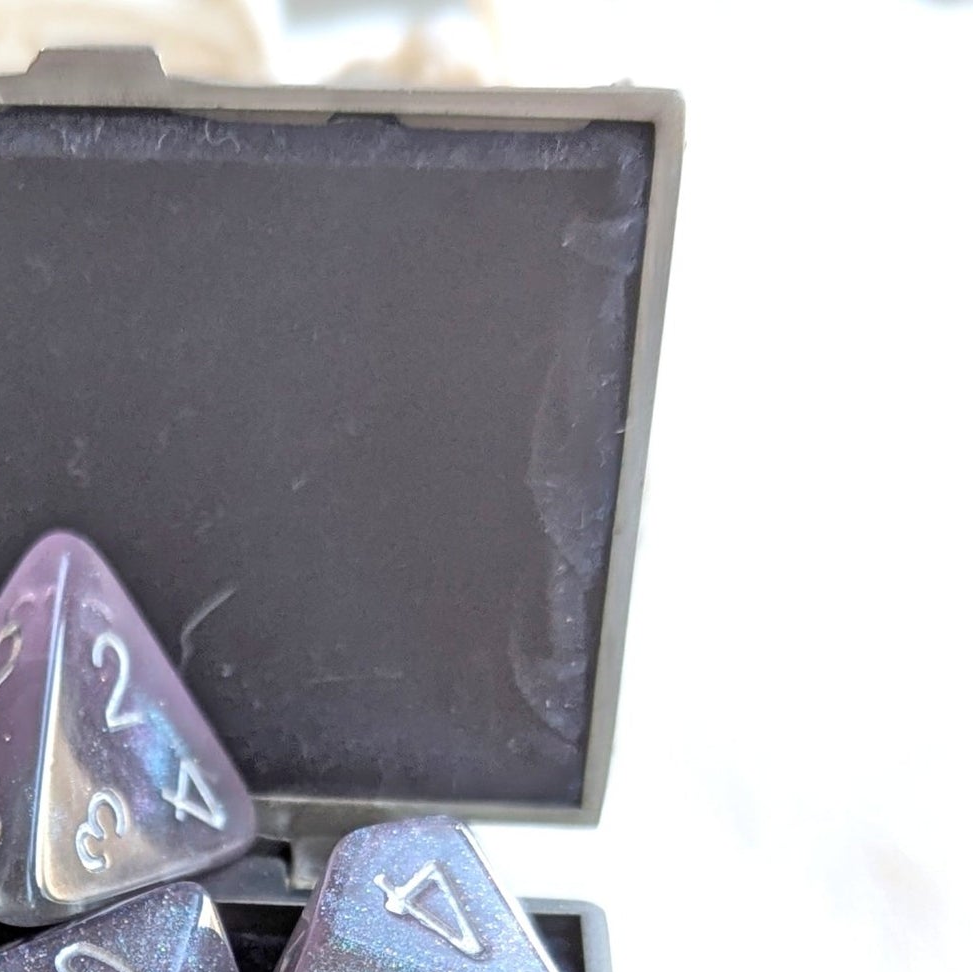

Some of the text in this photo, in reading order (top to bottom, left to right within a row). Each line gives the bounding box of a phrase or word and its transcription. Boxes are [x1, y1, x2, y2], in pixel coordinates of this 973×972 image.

[92, 631, 146, 733] 2
[75, 787, 129, 874] 3
[162, 757, 226, 832] 4
[373, 859, 489, 961] 4
